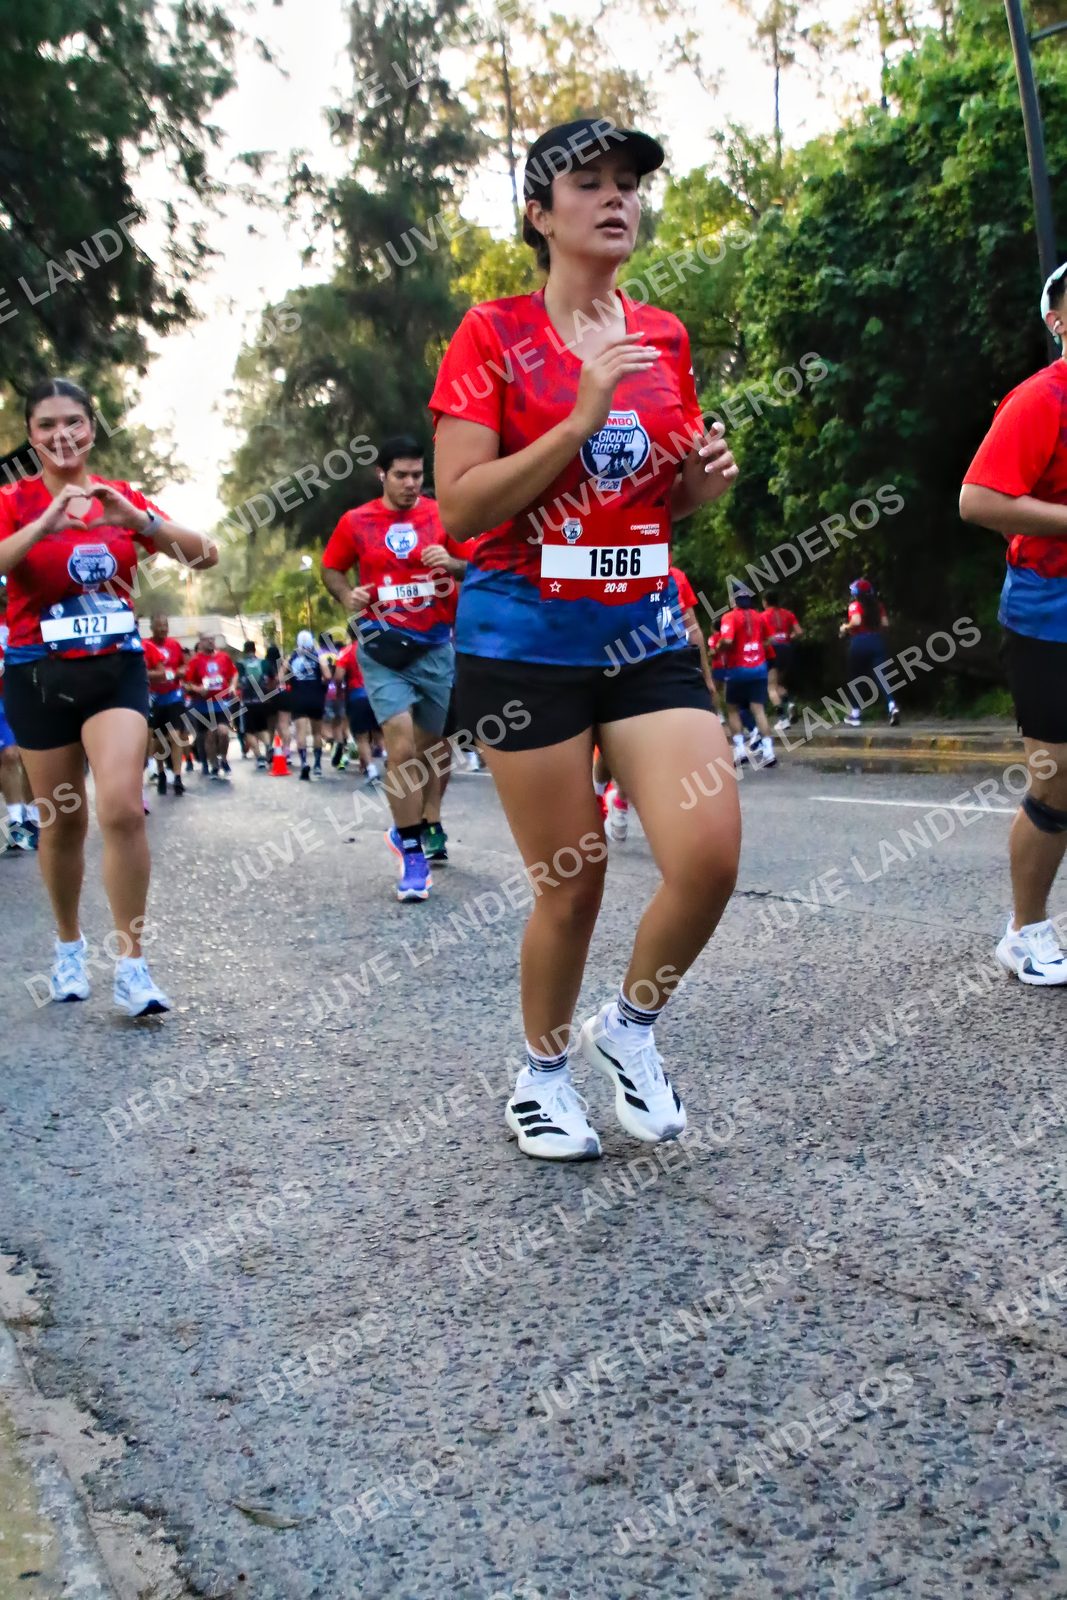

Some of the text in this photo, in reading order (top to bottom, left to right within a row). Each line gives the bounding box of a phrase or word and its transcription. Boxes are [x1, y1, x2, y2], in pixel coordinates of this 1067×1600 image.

[607, 417, 633, 426] MBO
[598, 430, 634, 443] Global
[591, 442, 620, 454] Race
[589, 548, 641, 577] 1566
[650, 593, 660, 602] 5K
[73, 616, 108, 634] 4727
